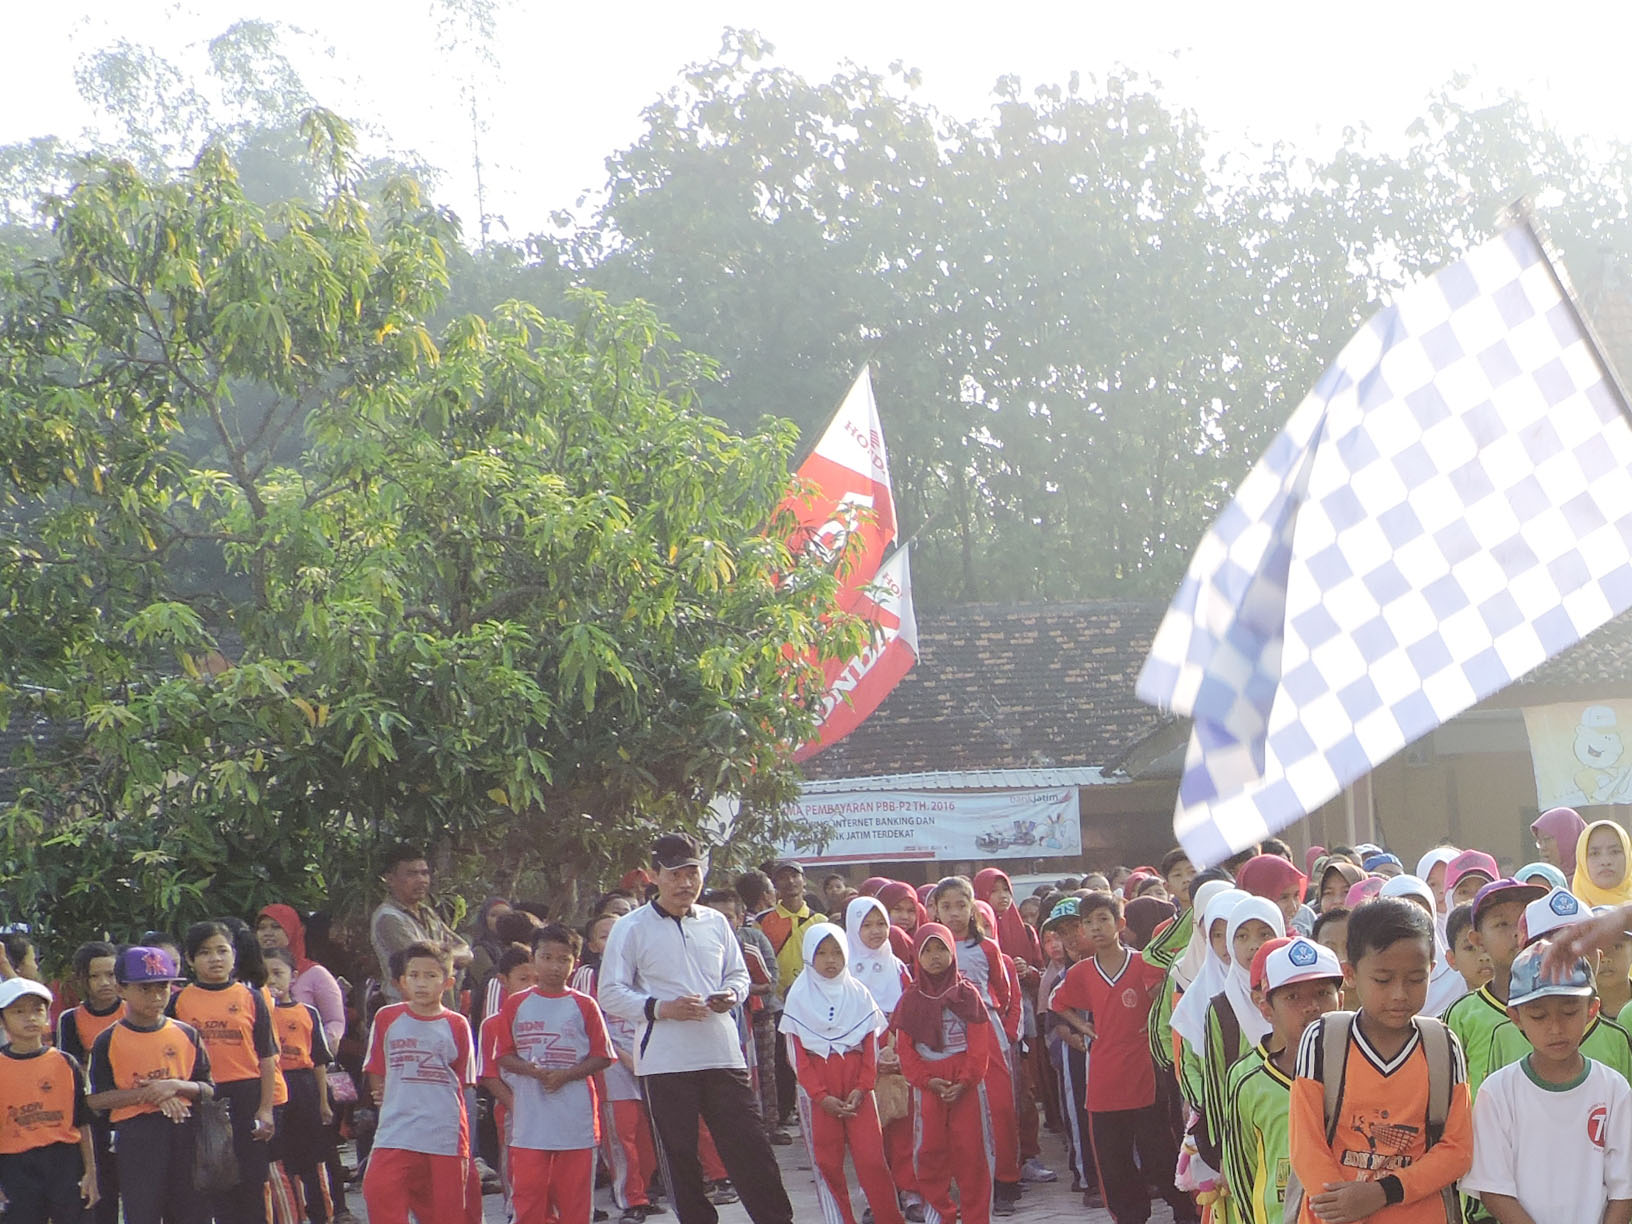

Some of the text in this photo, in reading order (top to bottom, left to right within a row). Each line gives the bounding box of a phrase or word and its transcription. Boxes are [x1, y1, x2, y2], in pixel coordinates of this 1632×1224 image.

[805, 801, 874, 816] PEMBAYARAN
[930, 800, 956, 811] 2016
[875, 816, 915, 827] BANKING
[915, 816, 936, 826] DAN
[873, 829, 915, 840] TERDEKAT
